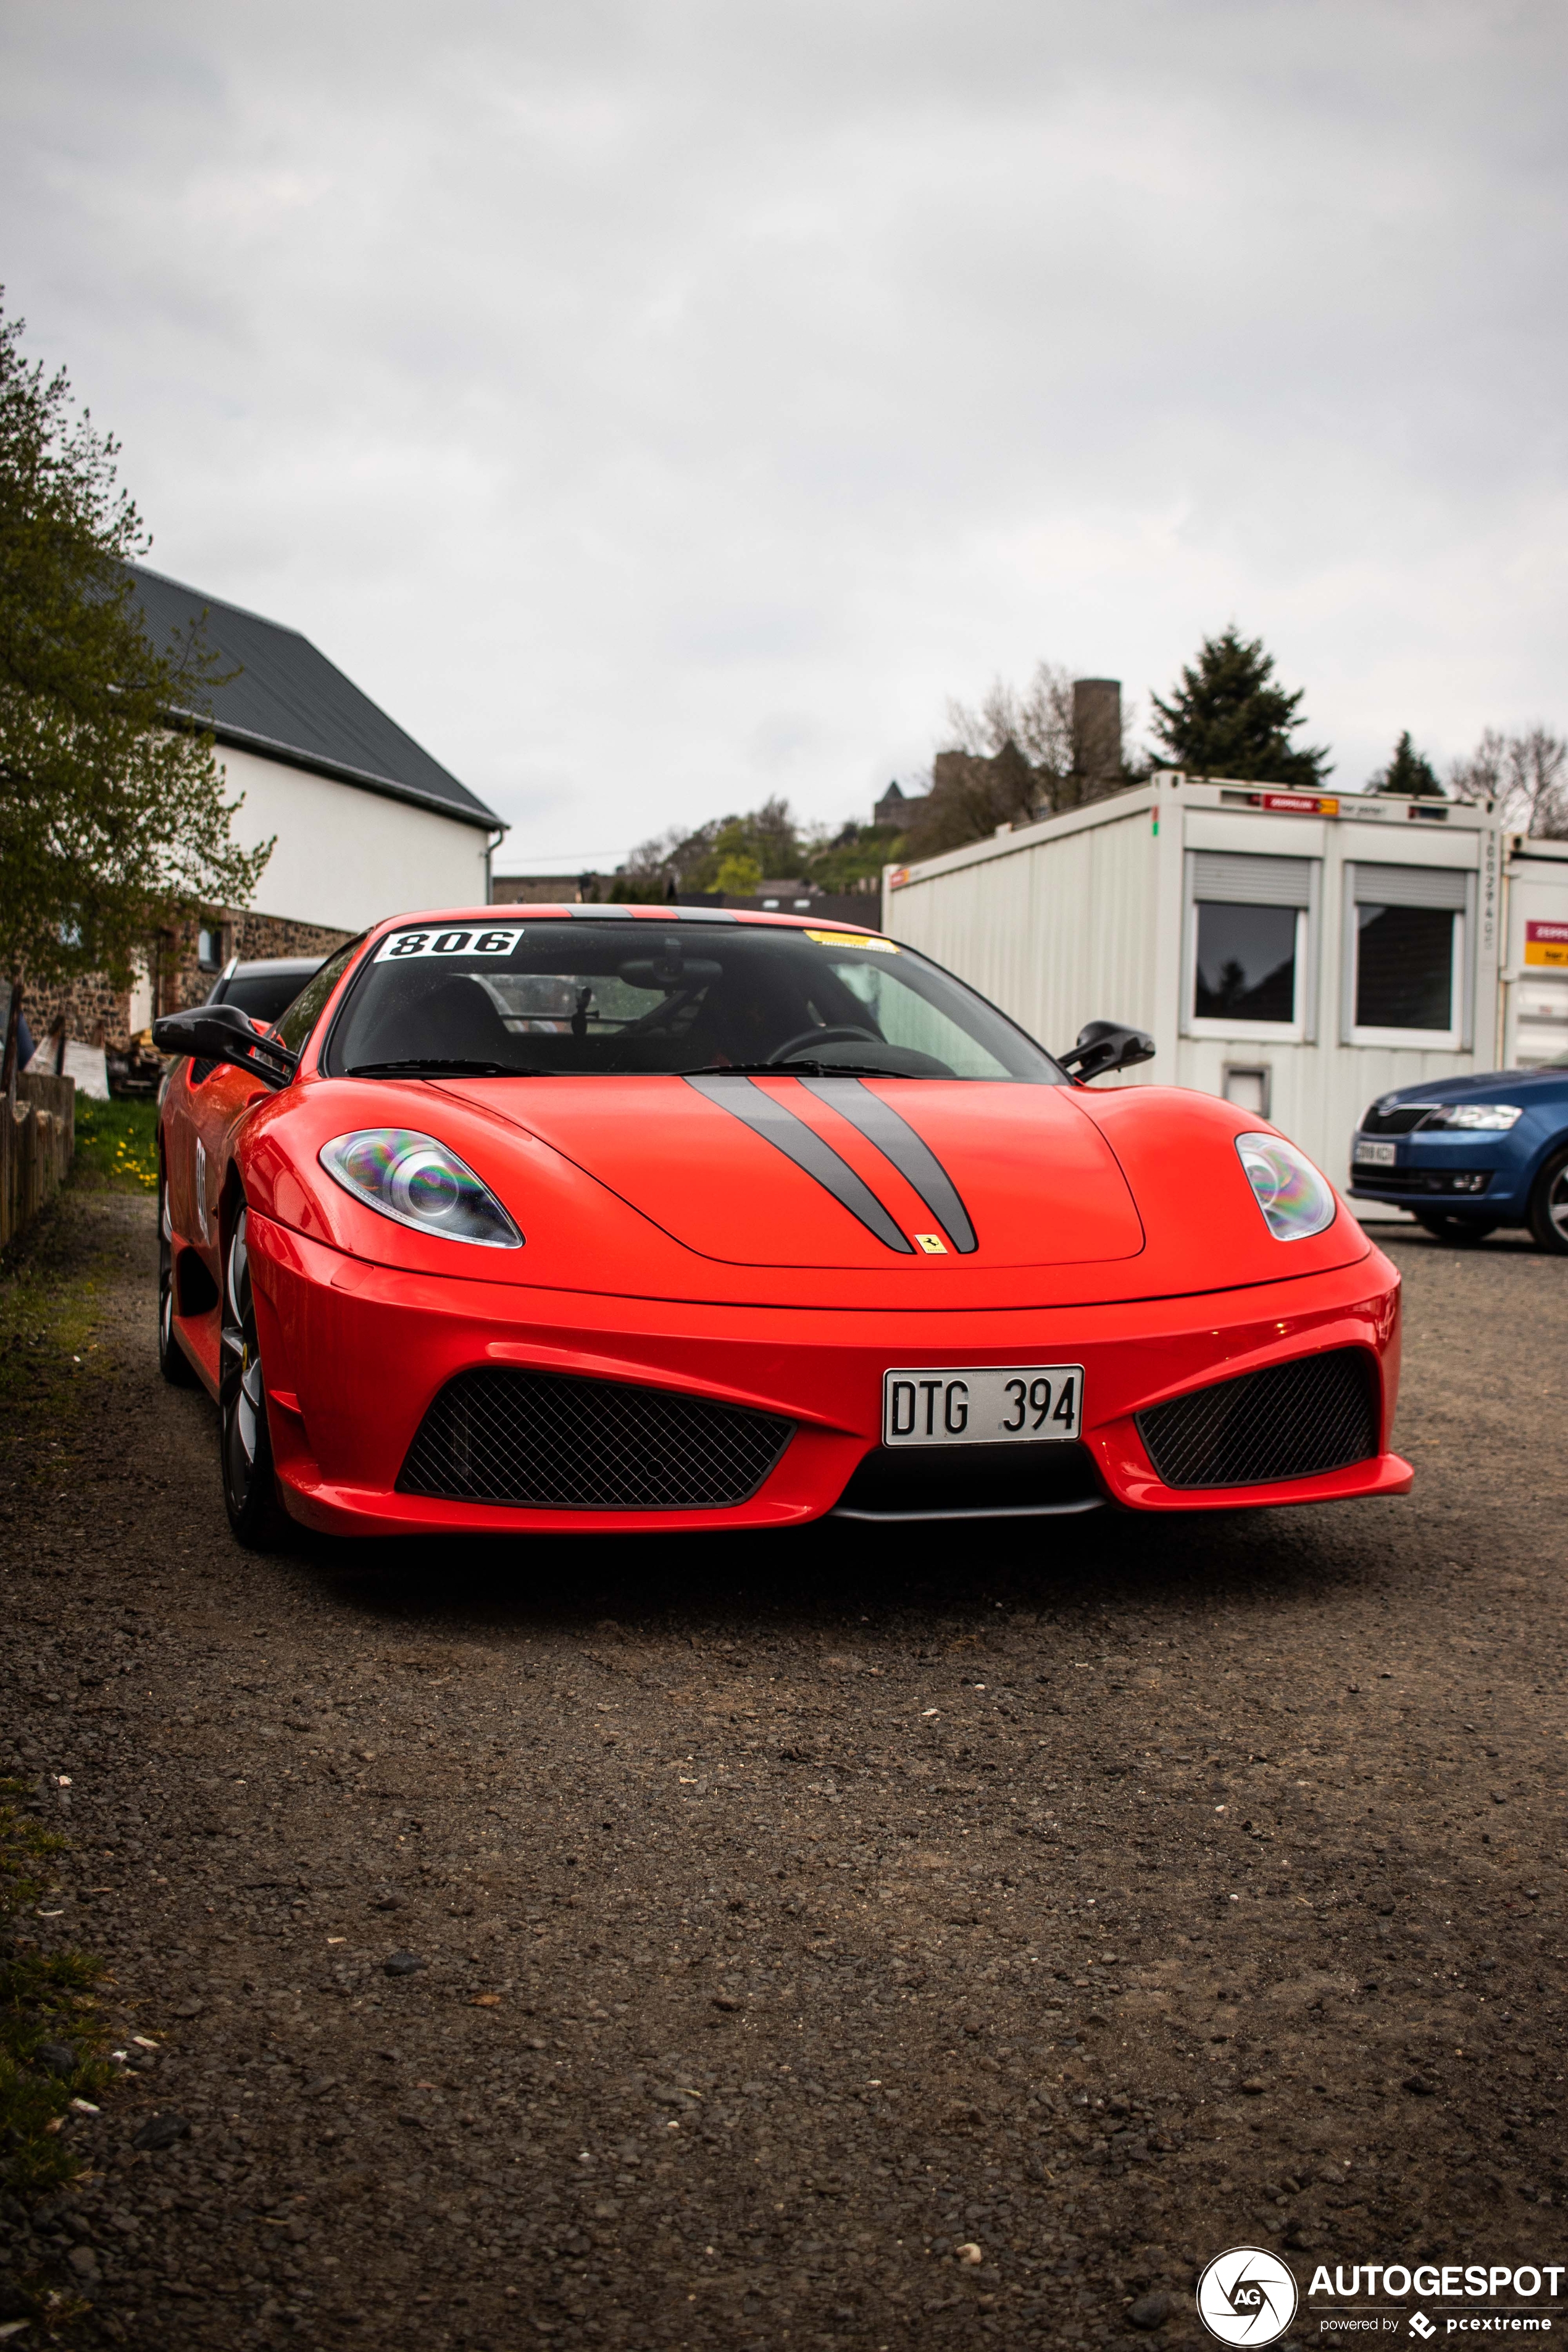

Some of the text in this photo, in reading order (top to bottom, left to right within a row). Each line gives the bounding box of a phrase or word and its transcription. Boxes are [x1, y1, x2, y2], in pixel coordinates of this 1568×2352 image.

[389, 932, 515, 956] 806
[891, 1376, 1075, 1435] DTG 394
